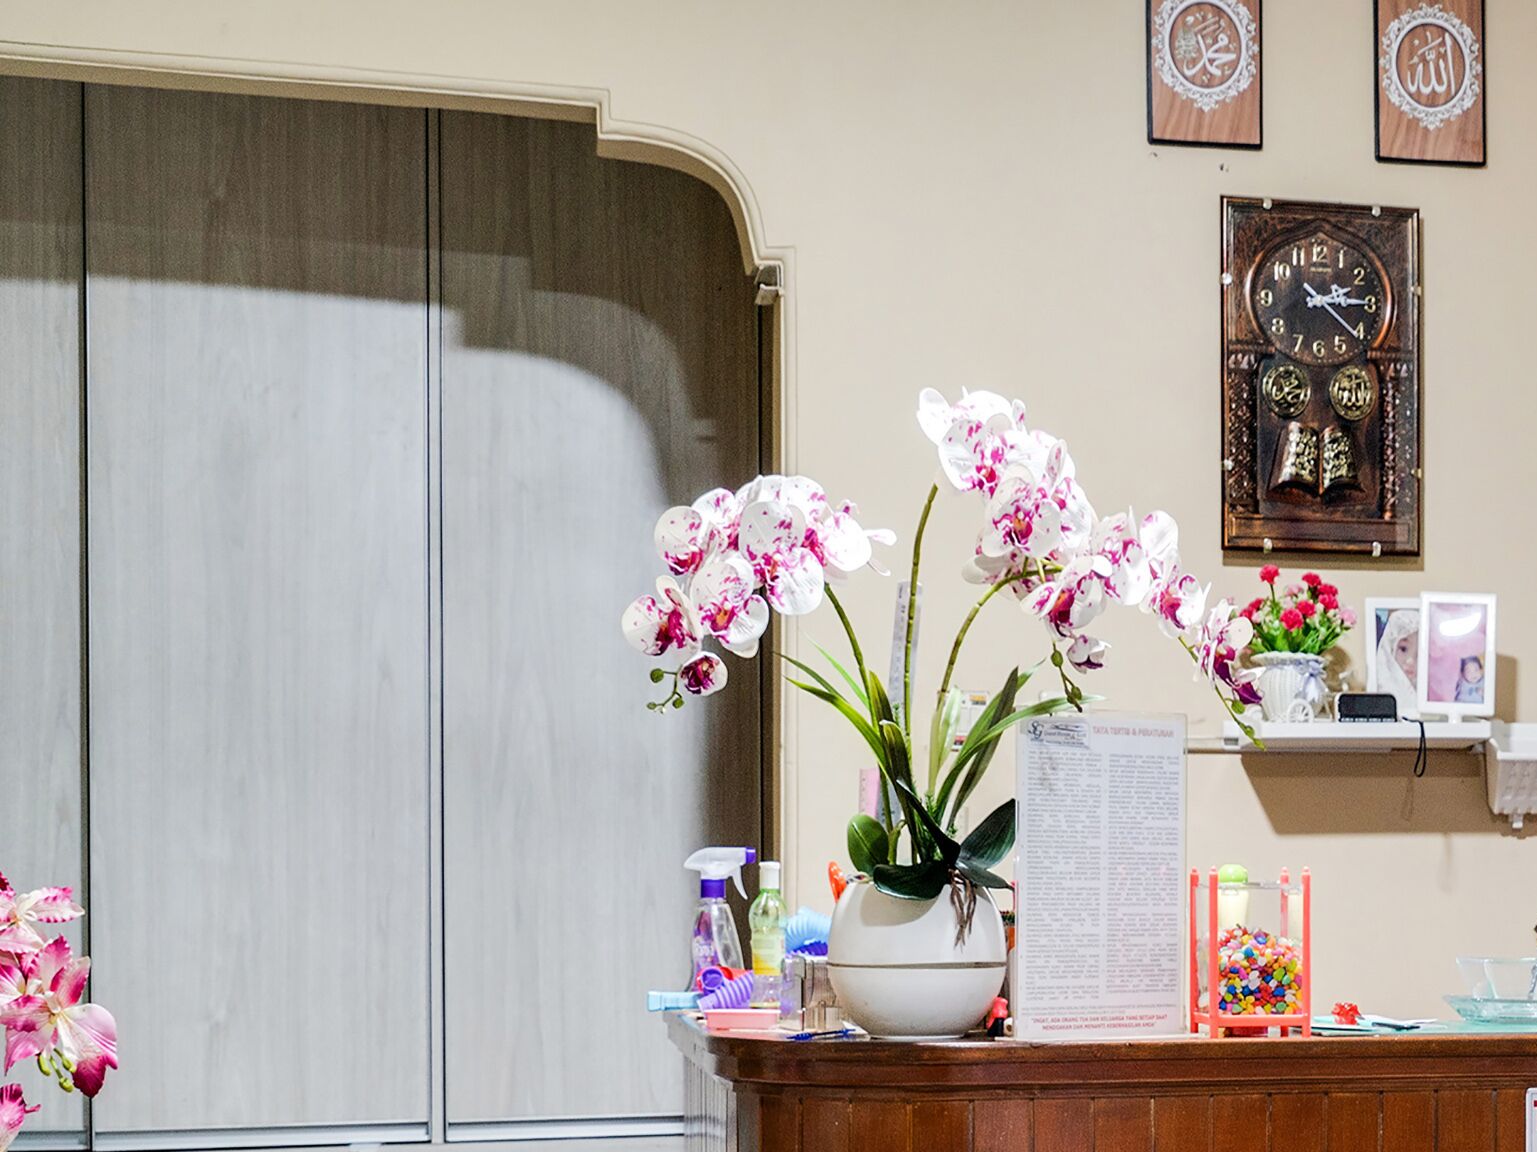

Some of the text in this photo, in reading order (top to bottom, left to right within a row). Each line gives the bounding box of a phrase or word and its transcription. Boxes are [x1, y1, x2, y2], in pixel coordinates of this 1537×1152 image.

[1292, 247, 1305, 266] 11
[1312, 243, 1328, 262] 12
[1339, 249, 1344, 269] 1
[1274, 261, 1291, 281] 10
[1353, 267, 1365, 285] 2
[1260, 289, 1273, 307] 9
[1363, 295, 1376, 313] 3
[1271, 317, 1284, 335] 8
[1355, 321, 1364, 340] 4
[1293, 334, 1304, 353] 7
[1312, 340, 1325, 358] 6
[1334, 335, 1347, 354] 5
